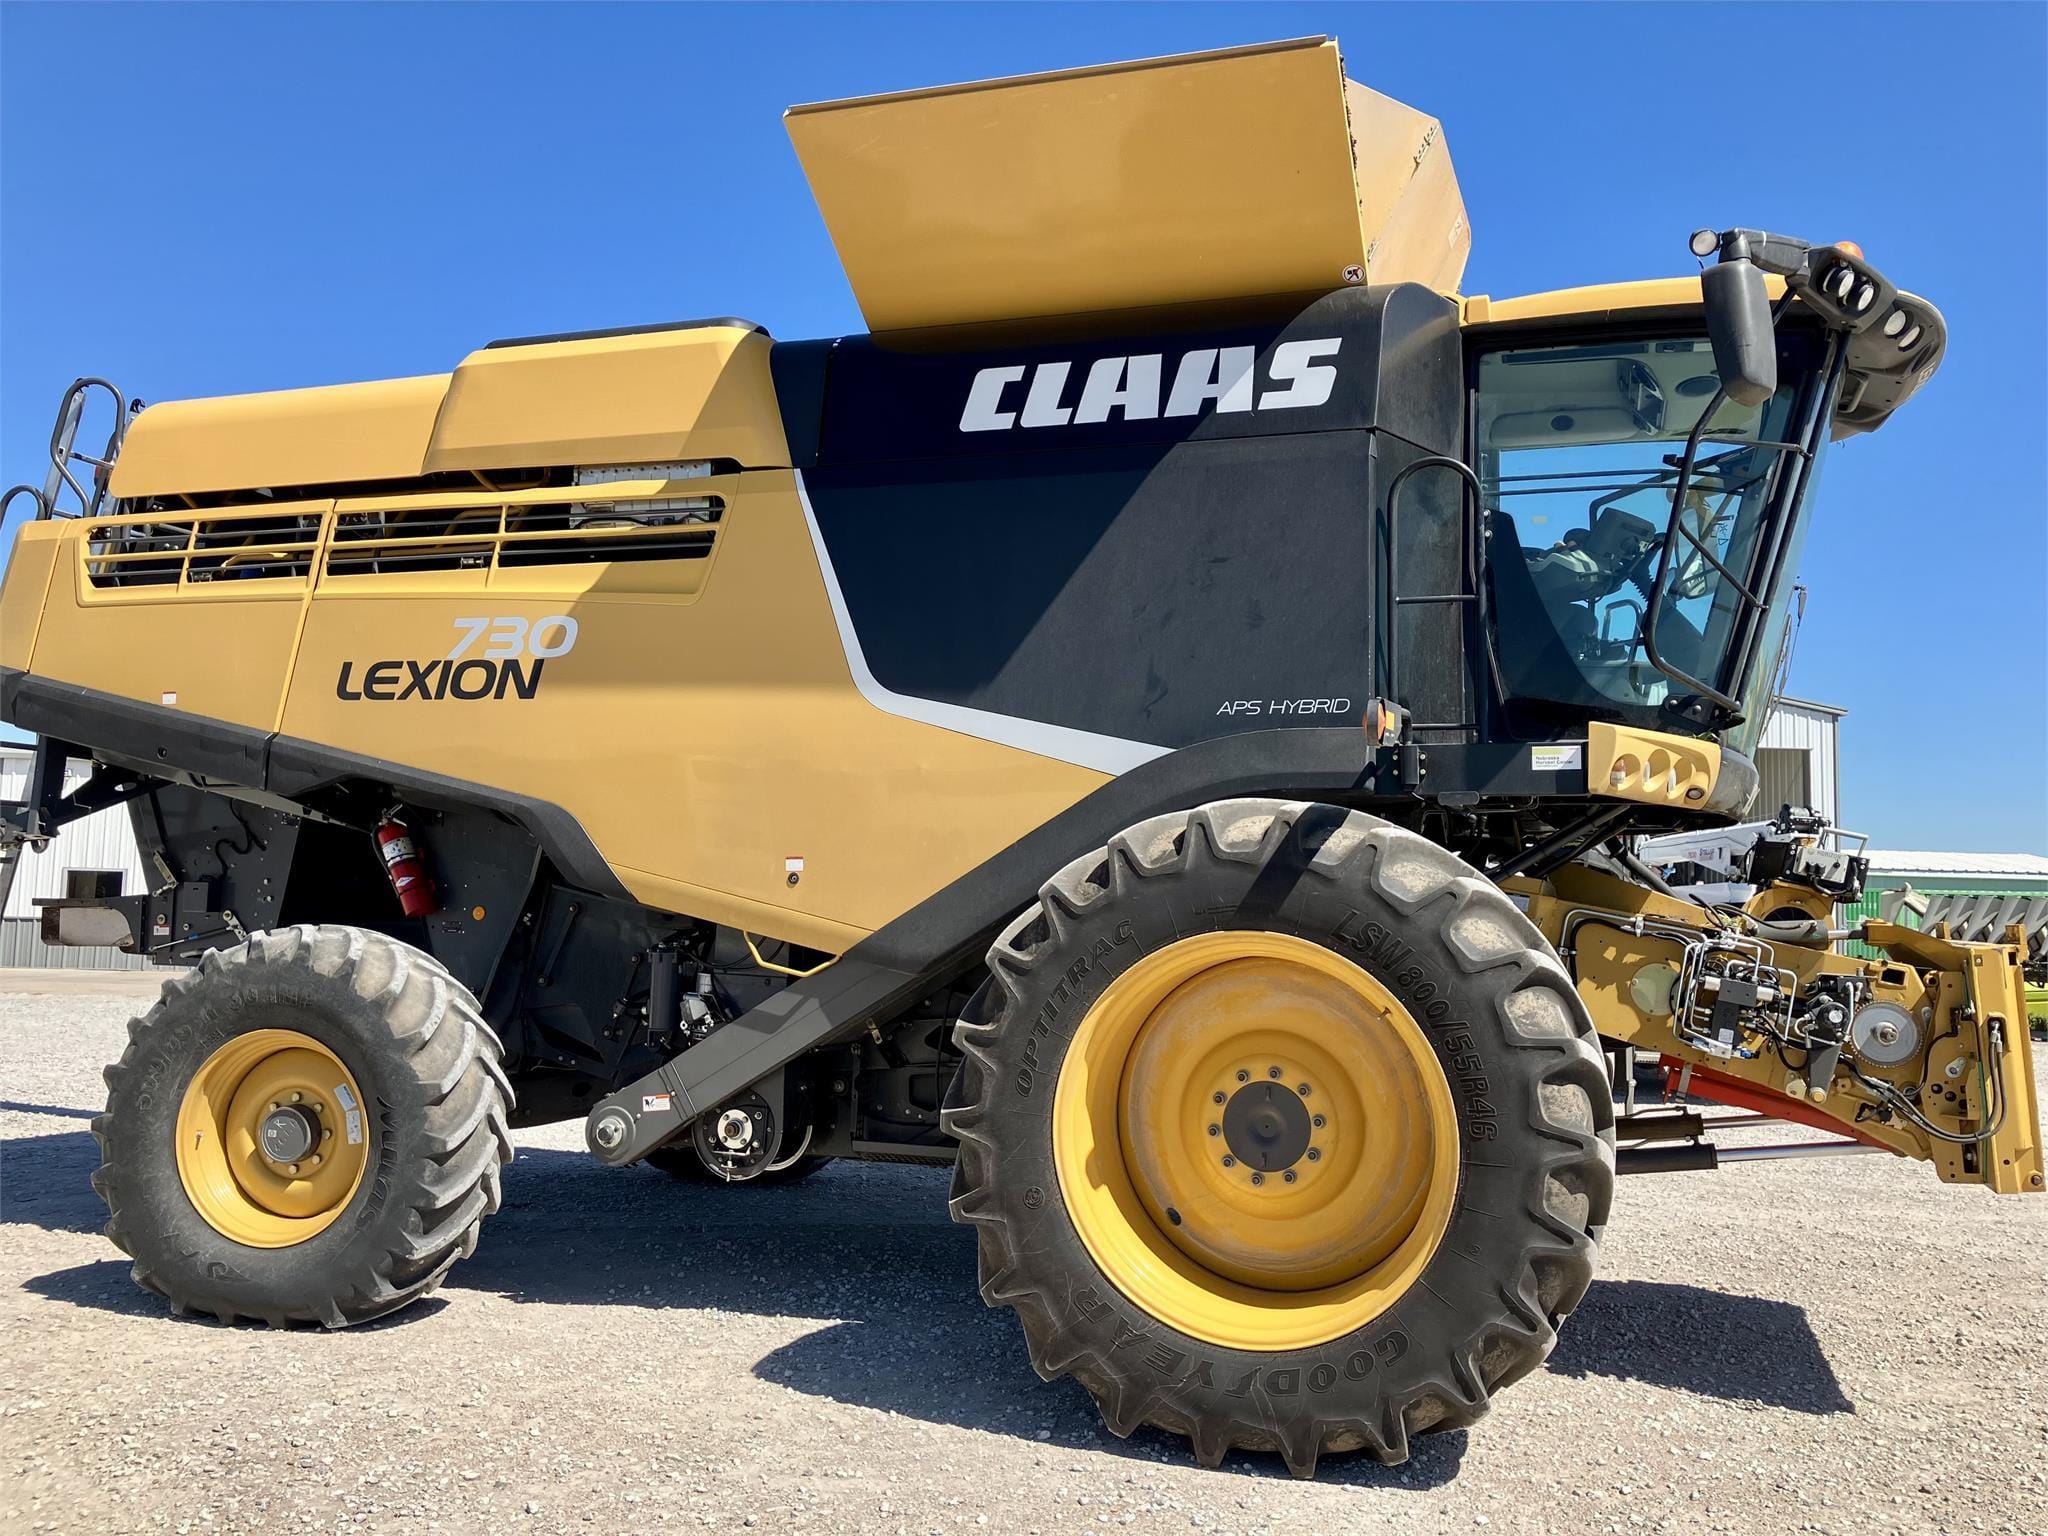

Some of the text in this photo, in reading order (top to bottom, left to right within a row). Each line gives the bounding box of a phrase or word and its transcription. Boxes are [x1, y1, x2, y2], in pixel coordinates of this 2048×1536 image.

[959, 337, 1342, 432] CLAAS
[336, 658, 545, 701] LEXION
[447, 615, 579, 661] 730
[1216, 698, 1351, 715] APS HYBRID
[1015, 919, 1134, 1097] OPTITRAC
[1329, 908, 1498, 1142] LSW 800/55R46
[1073, 1283, 1410, 1399] GOODYEAR
